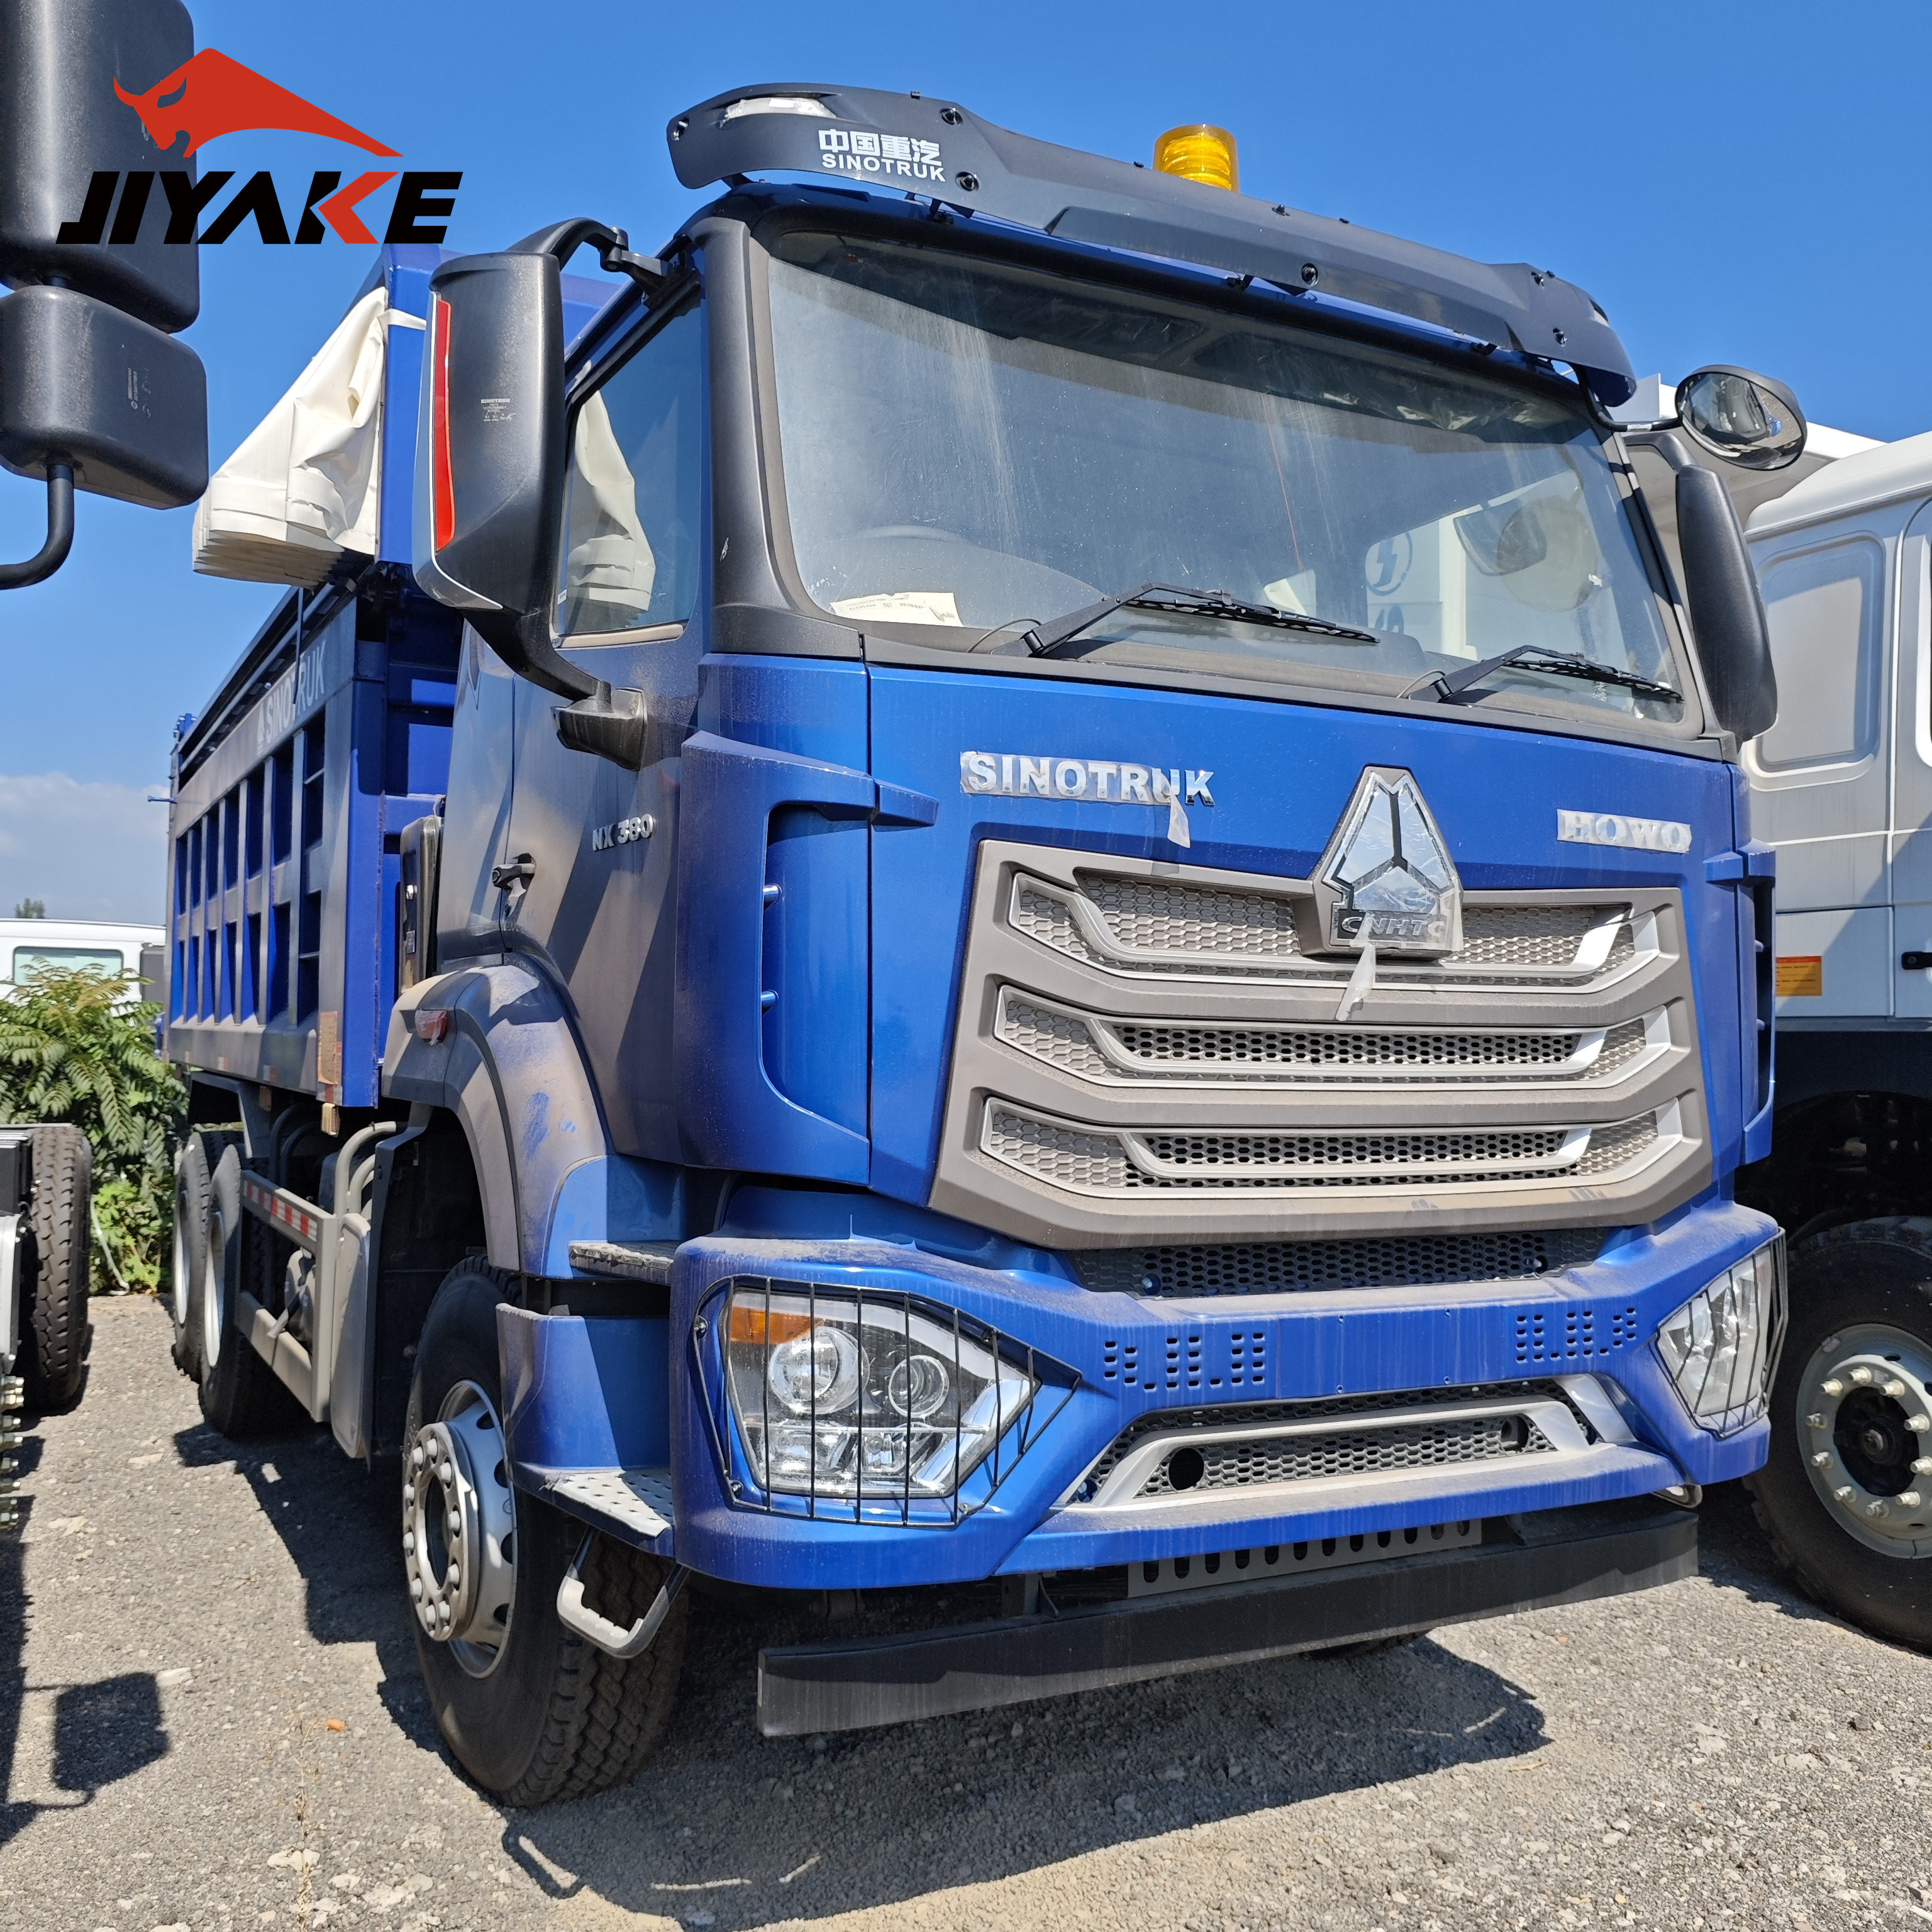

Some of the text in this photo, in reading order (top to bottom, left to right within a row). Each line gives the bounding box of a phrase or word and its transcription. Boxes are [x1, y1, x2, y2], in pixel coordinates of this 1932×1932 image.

[818, 129, 941, 166] 中国重汽
[822, 153, 945, 182] SINOTRUK
[968, 755, 1215, 806] SINOTRUK
[592, 814, 653, 851] NX 380
[1560, 813, 1688, 852] HOWO
[1341, 916, 1445, 937] CNHTC
